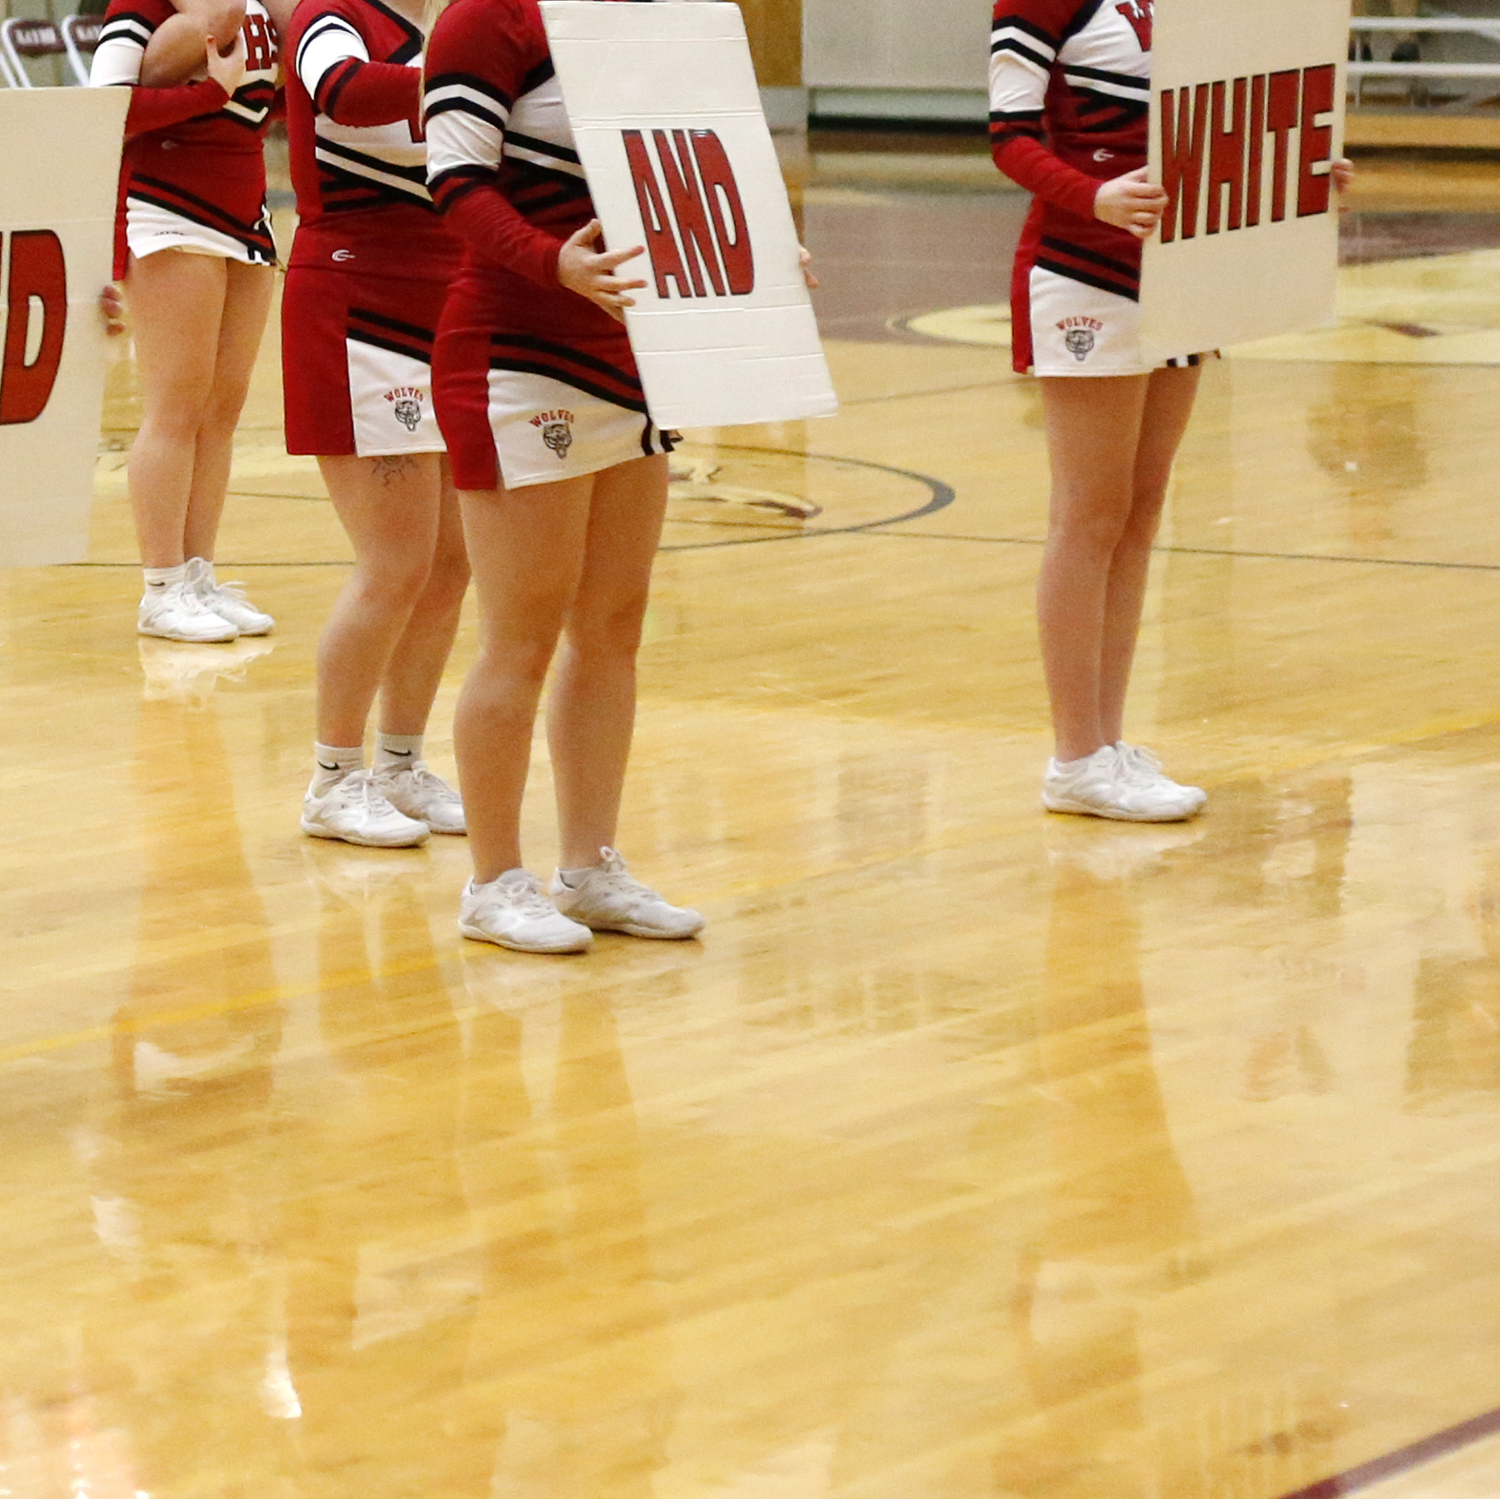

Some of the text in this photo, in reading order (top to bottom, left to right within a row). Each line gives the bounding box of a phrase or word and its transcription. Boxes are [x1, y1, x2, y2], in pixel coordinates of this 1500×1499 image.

[1160, 63, 1336, 244] WHITE
[621, 129, 754, 299] AND
[1055, 315, 1104, 332] WOLVES
[384, 387, 424, 404] WOLVES
[529, 409, 575, 429] WOLVES
